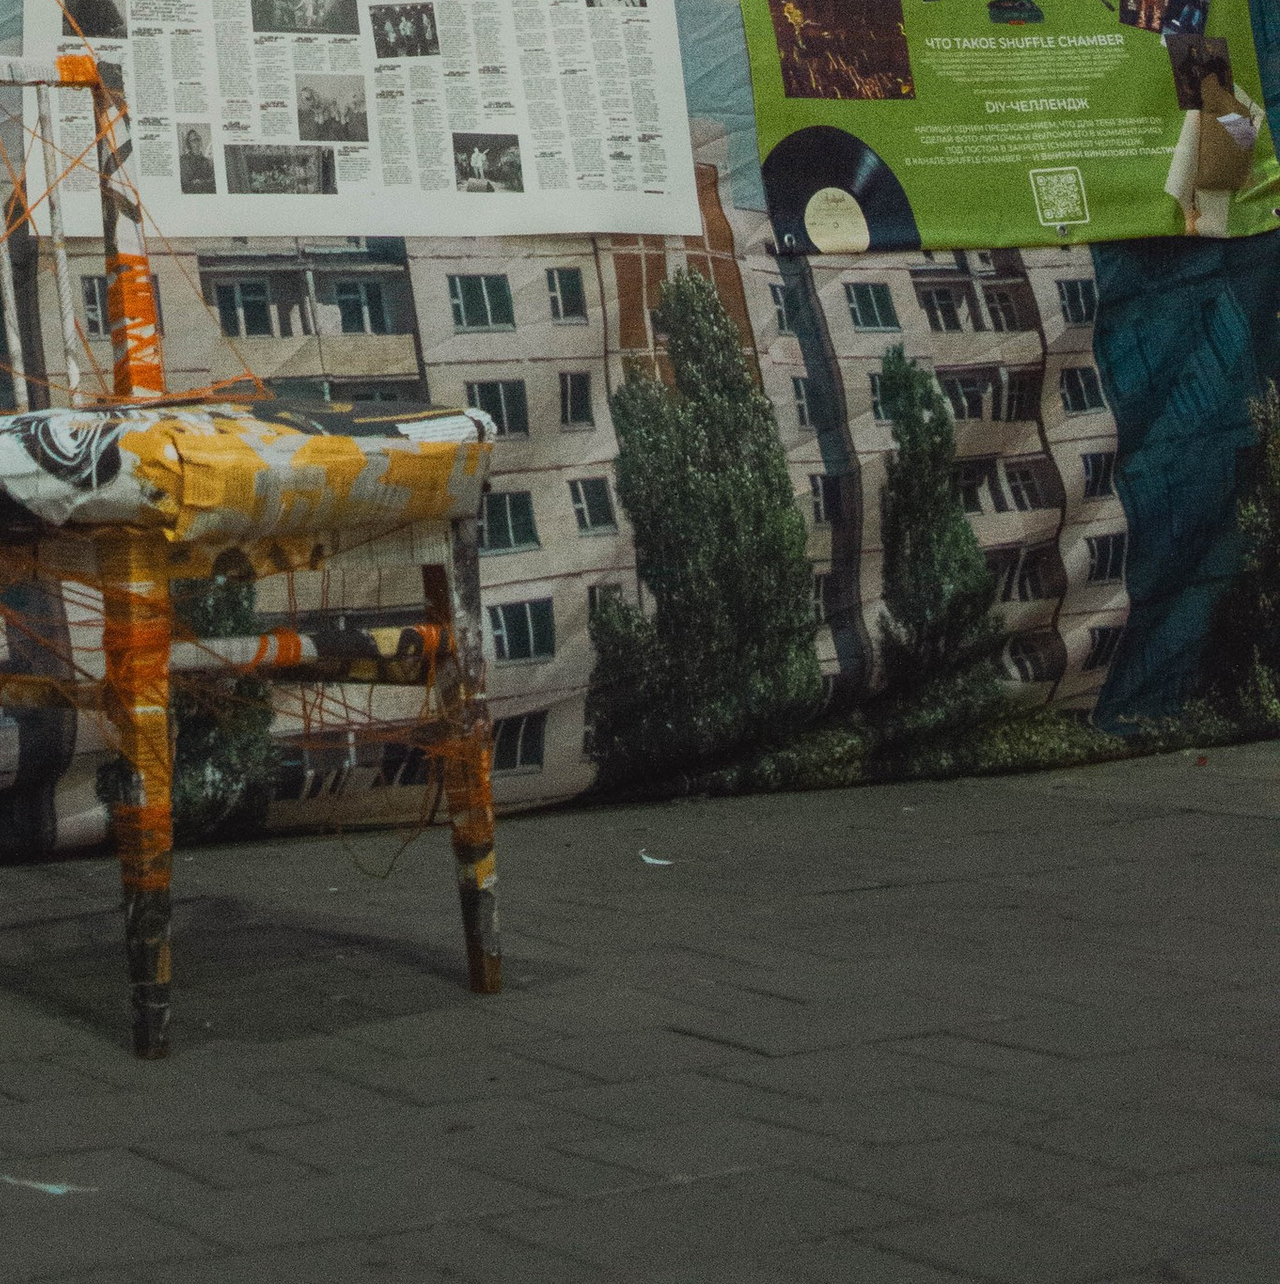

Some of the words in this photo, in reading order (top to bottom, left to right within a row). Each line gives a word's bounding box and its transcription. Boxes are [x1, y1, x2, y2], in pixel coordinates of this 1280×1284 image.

[925, 37, 952, 50] ЧТО
[954, 37, 997, 49] ТАКОЕ
[998, 35, 1055, 49] SHUFFLE
[1058, 33, 1125, 47] CHAMBER
[985, 98, 1090, 114] DIY-ЧЕЛЛЕНДЖ
